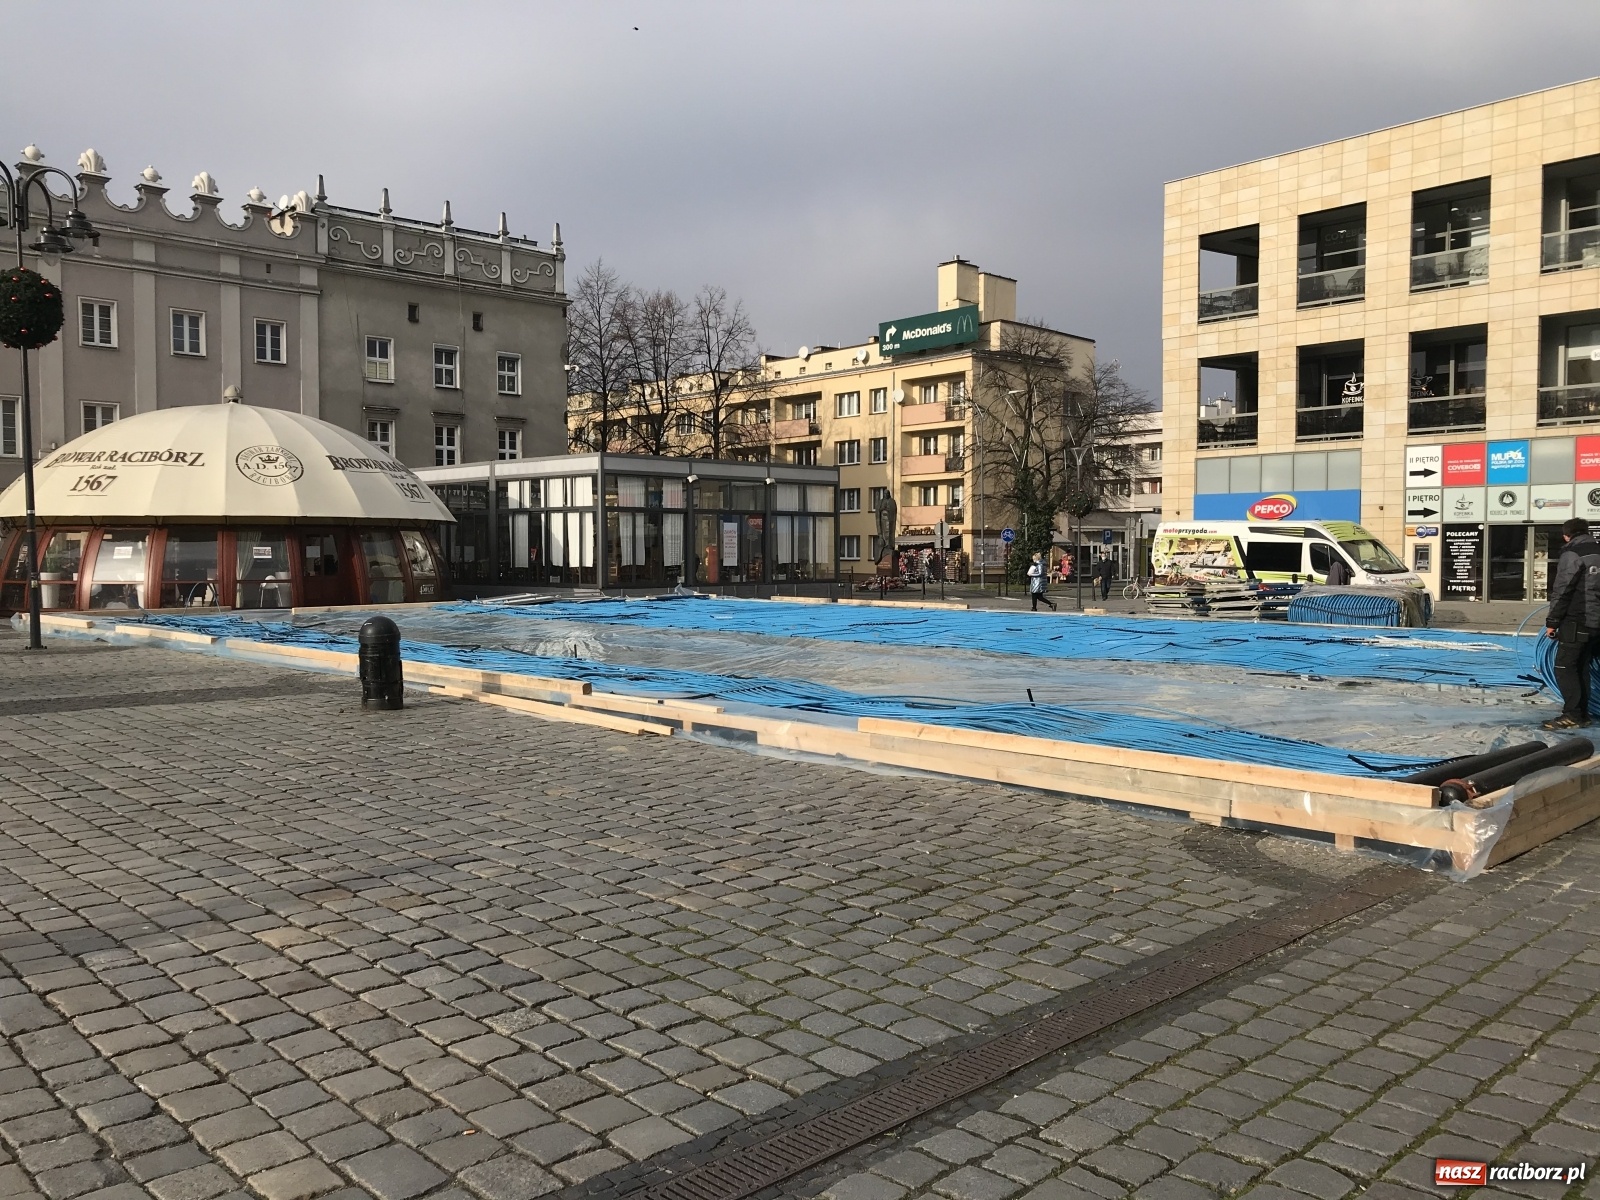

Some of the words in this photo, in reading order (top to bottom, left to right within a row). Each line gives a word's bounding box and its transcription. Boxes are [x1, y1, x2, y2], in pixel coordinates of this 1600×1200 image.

[902, 323, 952, 340] McDonald's
[882, 344, 893, 352] 300
[105, 449, 206, 468] RACIBÓRZ
[1416, 456, 1440, 464] PIĘTRO
[1491, 451, 1526, 461] MUPOL
[70, 474, 119, 493] 1567
[395, 482, 425, 500] 1567
[1413, 495, 1440, 503] PIĘTRO
[1254, 503, 1289, 515] PEPCO
[1104, 530, 1111, 541] P
[1451, 585, 1477, 593] PIĘTRO
